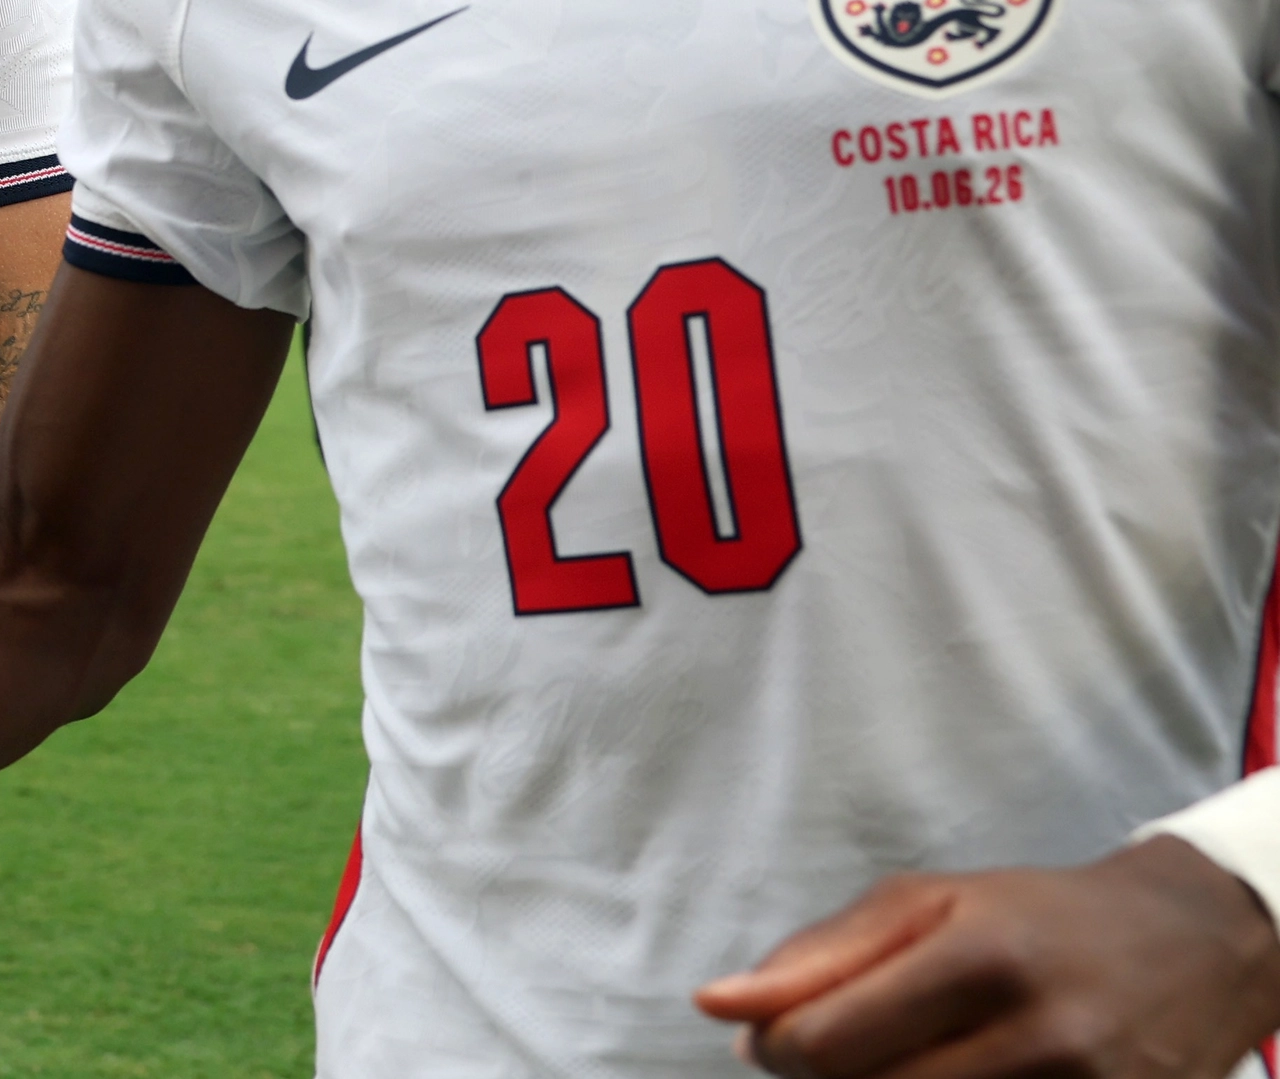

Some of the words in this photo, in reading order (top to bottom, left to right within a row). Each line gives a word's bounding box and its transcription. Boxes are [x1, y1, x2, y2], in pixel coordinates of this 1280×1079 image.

[831, 116, 961, 167] COSTA
[972, 107, 1060, 152] RICA
[883, 164, 1024, 215] 10.06.26
[475, 256, 803, 616] 20
